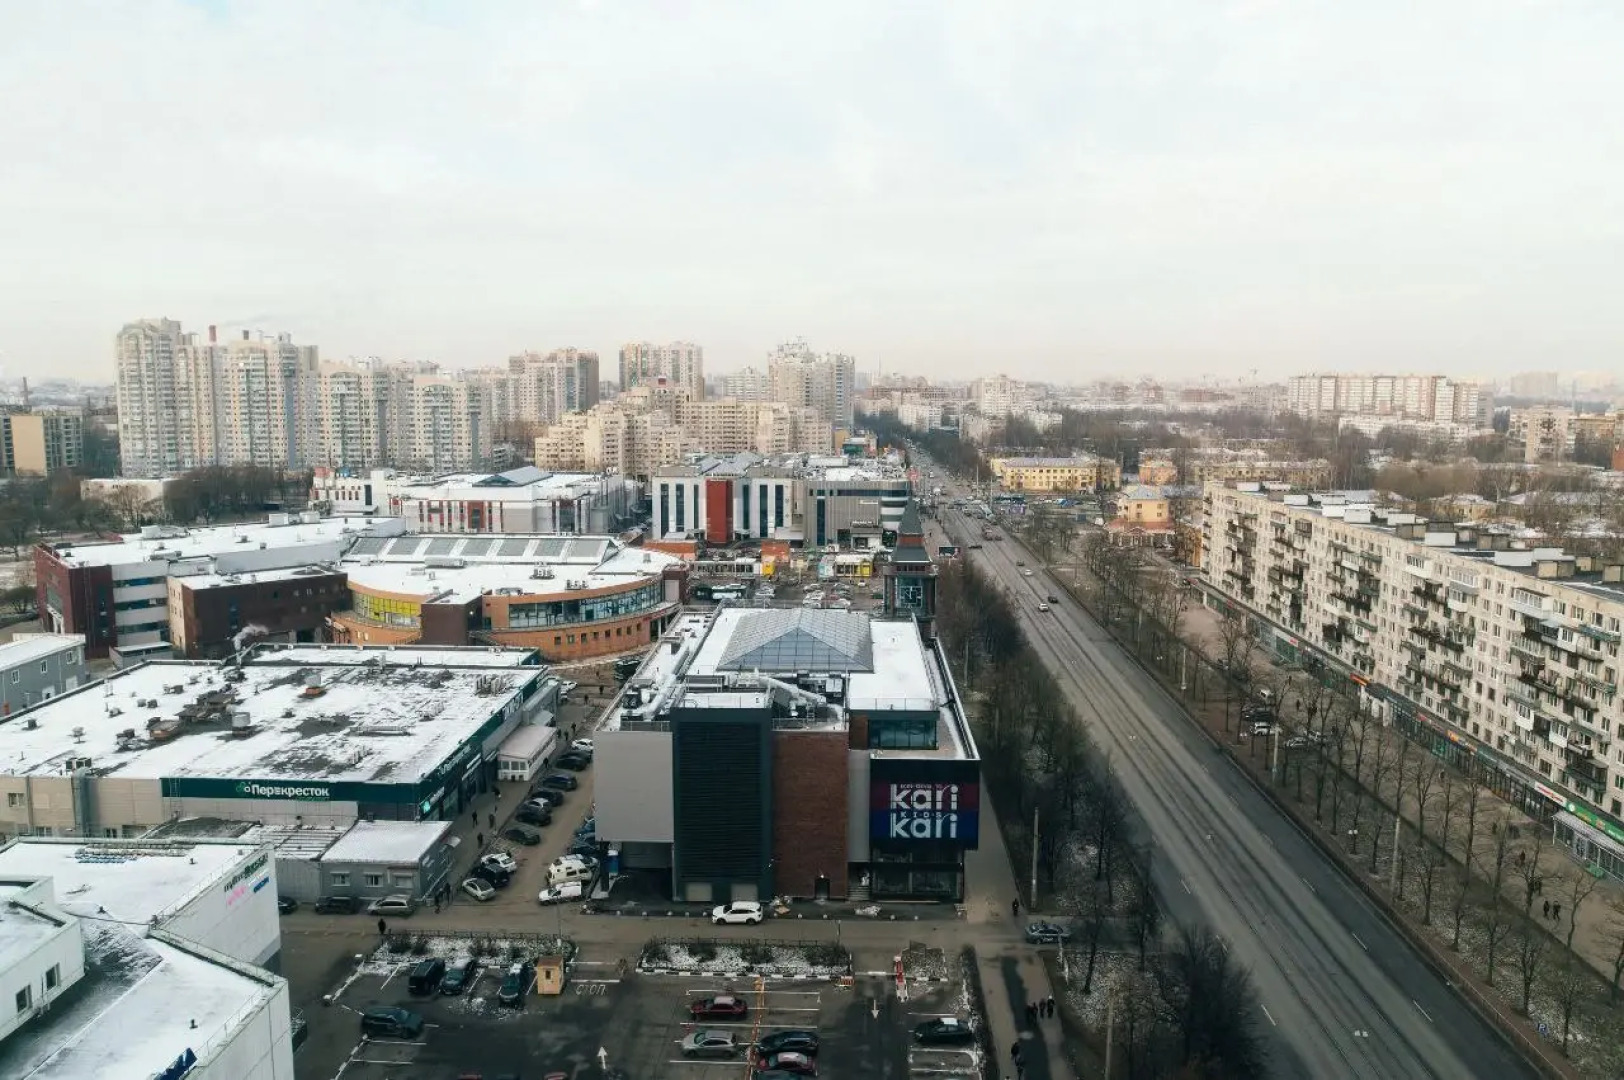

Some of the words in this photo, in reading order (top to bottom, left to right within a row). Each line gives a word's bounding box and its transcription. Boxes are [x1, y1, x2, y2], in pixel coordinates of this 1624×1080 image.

[251, 783, 330, 798] Перекресток
[890, 784, 959, 810] kari
[890, 812, 958, 838] kari
[575, 984, 606, 996] СТОП
